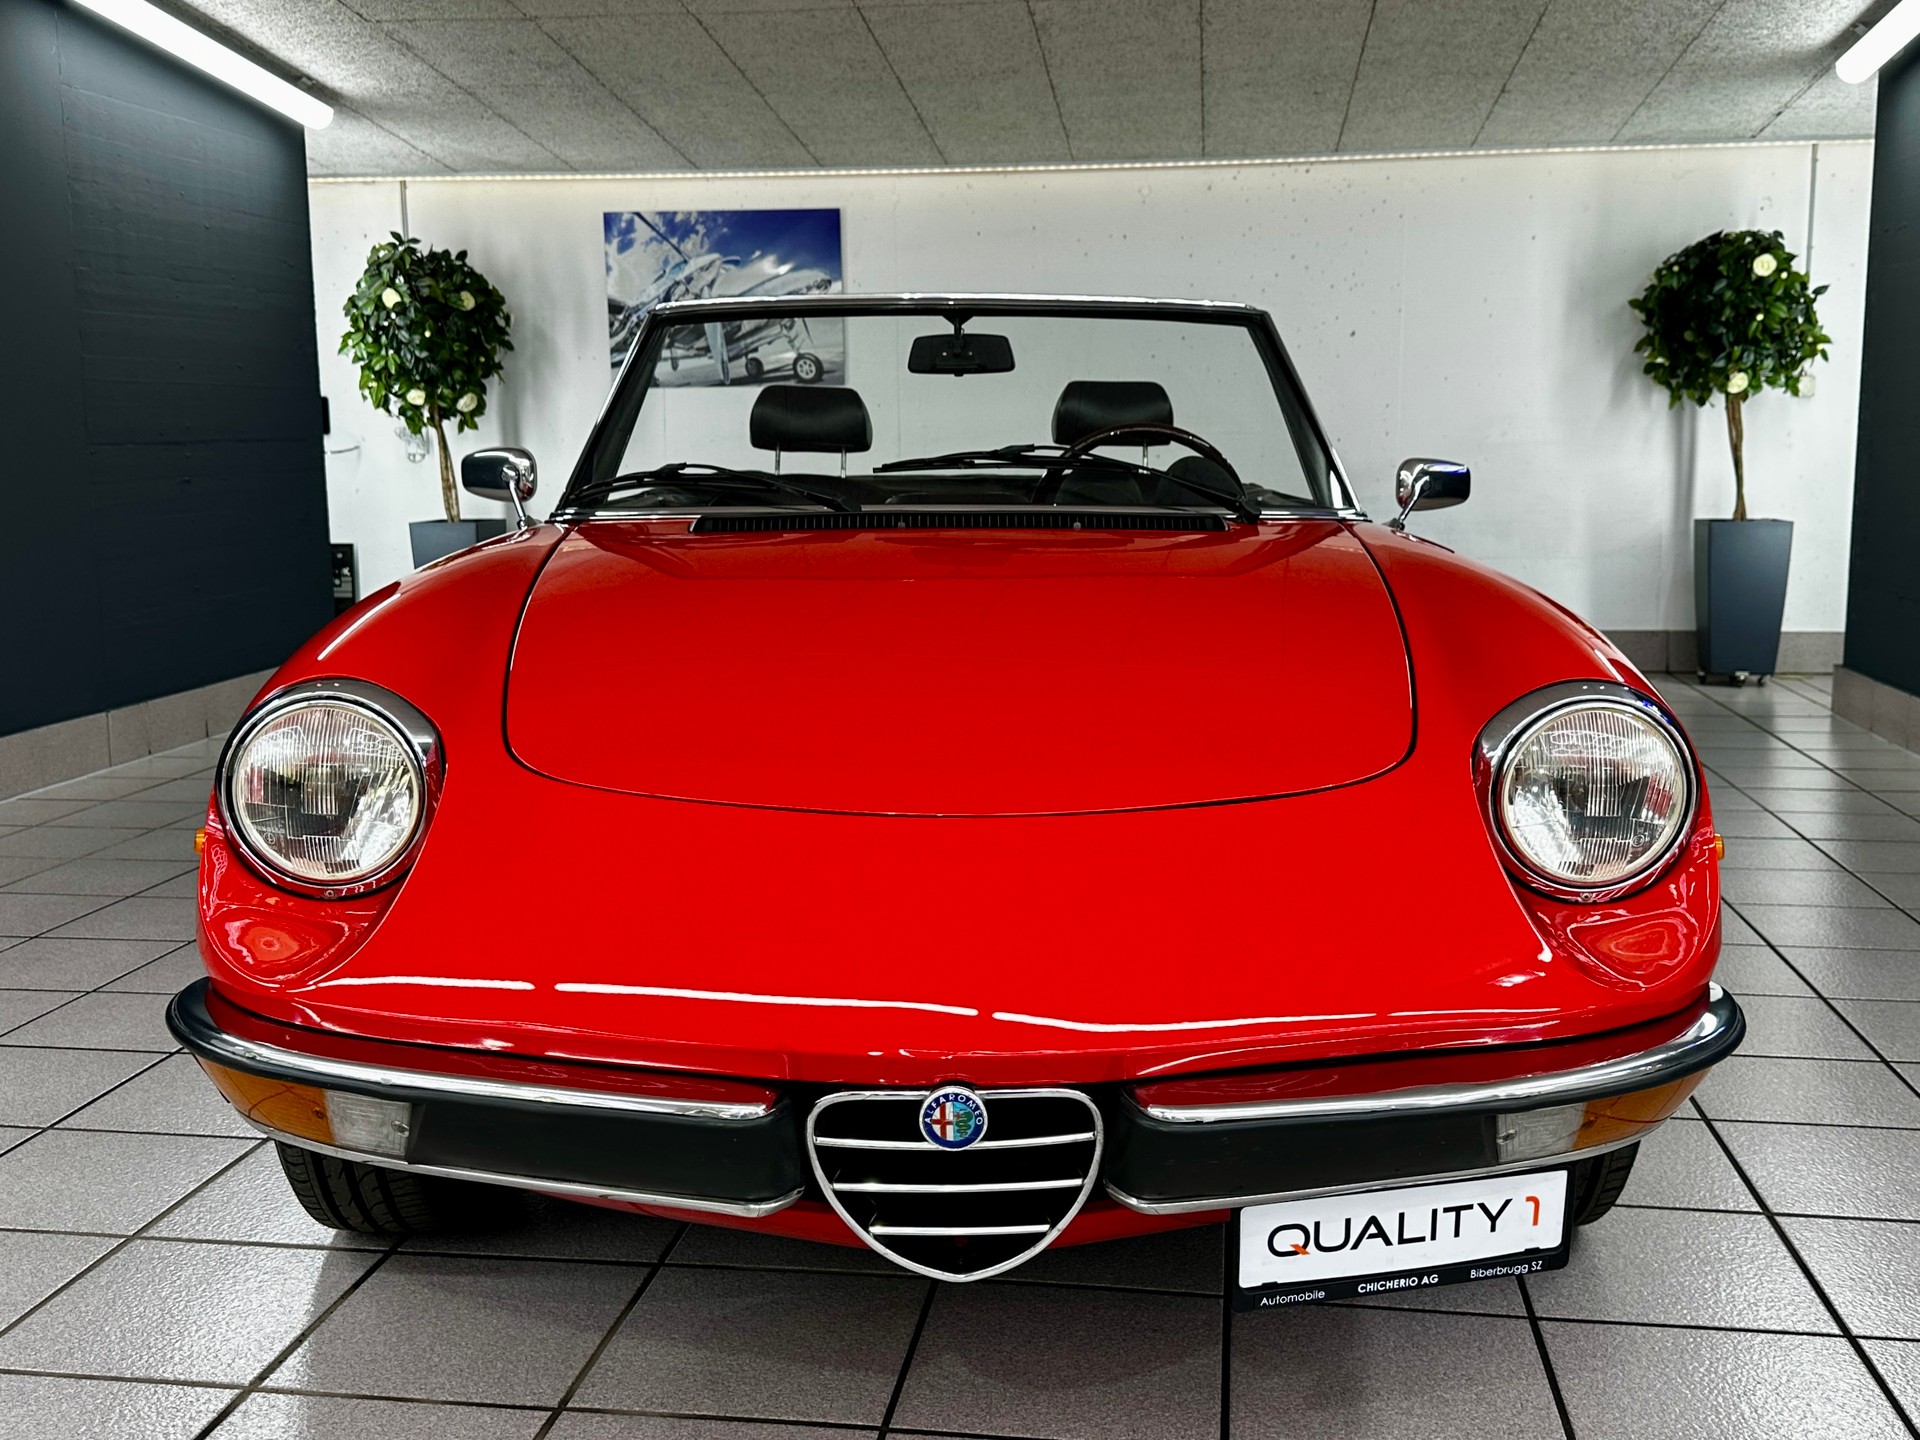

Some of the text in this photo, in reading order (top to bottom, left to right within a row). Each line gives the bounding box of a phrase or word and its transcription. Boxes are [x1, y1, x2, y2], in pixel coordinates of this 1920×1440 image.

[1267, 1198, 1514, 1258] QUALITY
[1470, 1260, 1543, 1279] Biberbrugg SZ
[1357, 1273, 1439, 1294] CHICHERIO AG
[1260, 1290, 1326, 1307] Automobile
